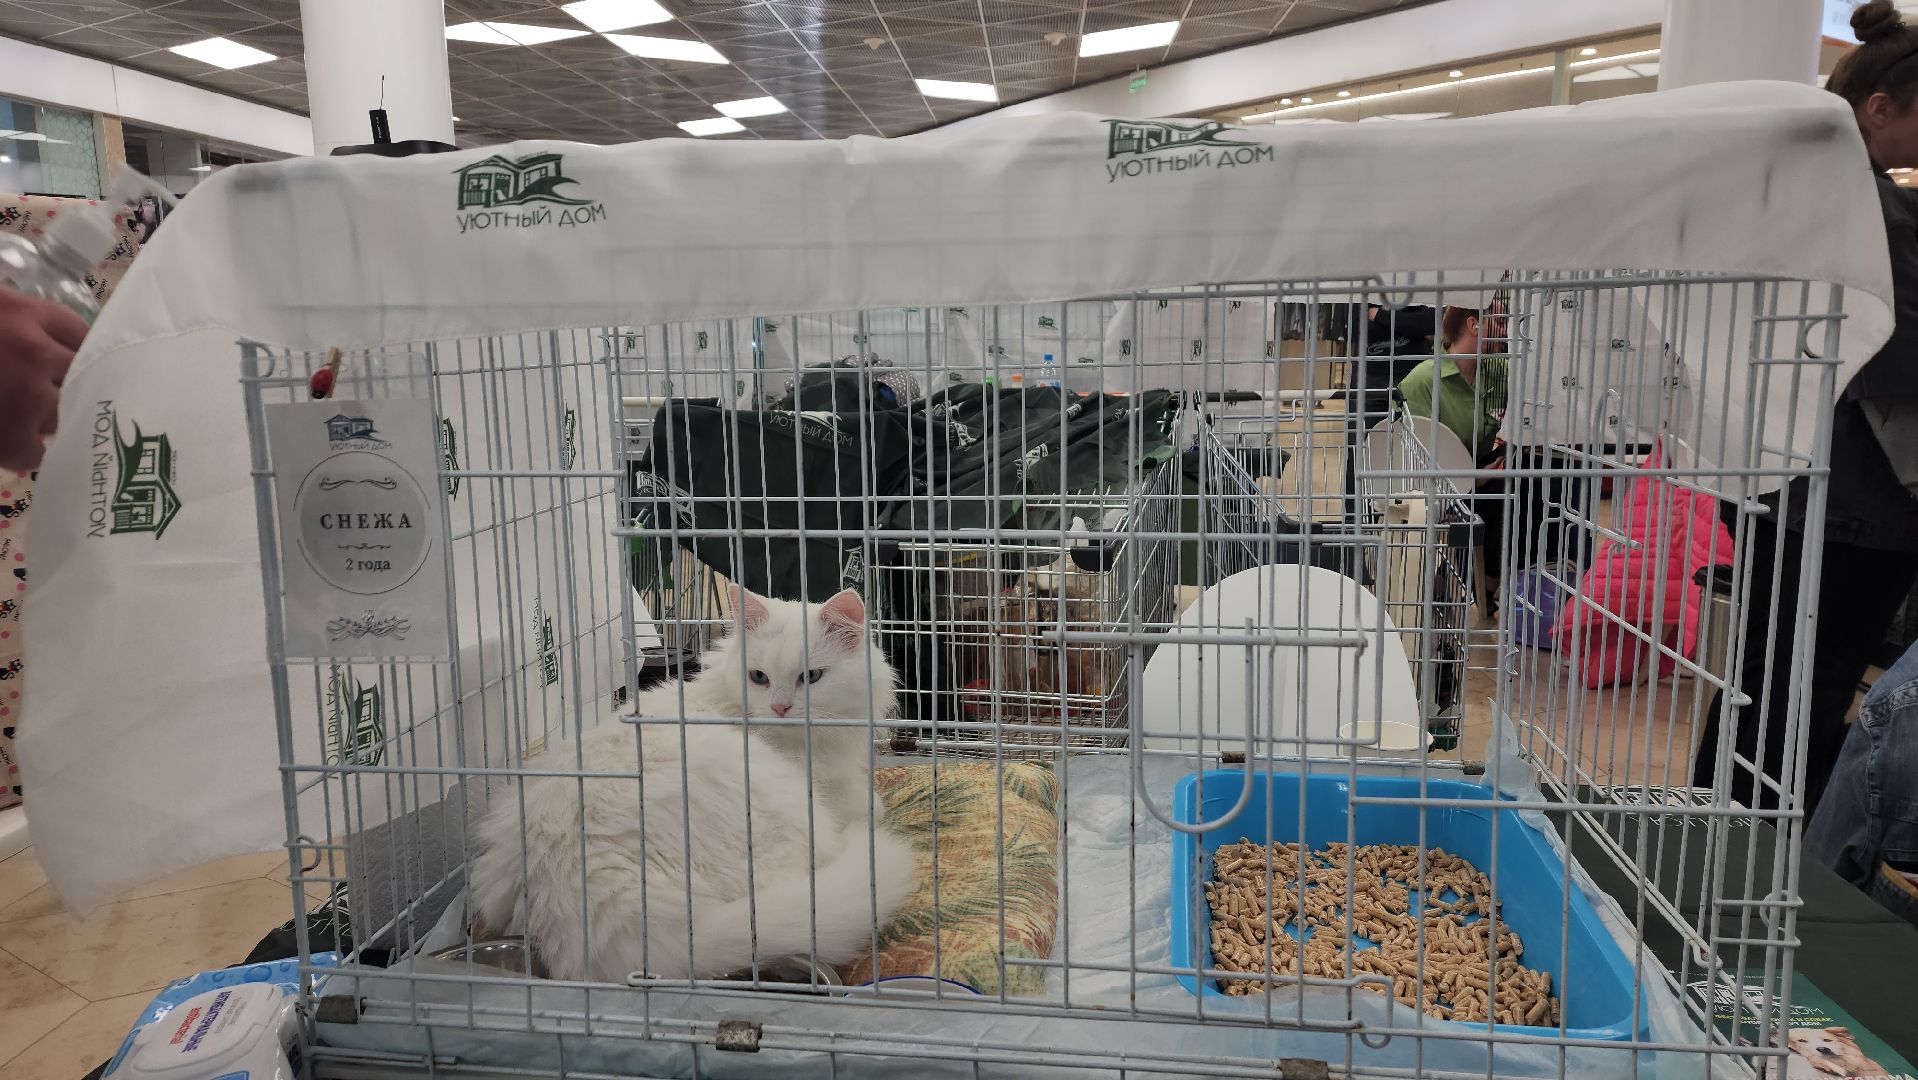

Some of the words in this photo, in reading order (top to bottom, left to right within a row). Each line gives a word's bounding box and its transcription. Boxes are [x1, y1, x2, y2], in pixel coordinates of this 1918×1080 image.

[1106, 149, 1211, 183] УЮТНЫЙ
[1217, 145, 1274, 169] ДОМ
[456, 205, 551, 233] УЮТНЫЙ
[558, 203, 606, 228] ДОМ
[320, 513, 412, 529] СНЕЖА
[346, 558, 354, 570] 2
[358, 560, 391, 572] года
